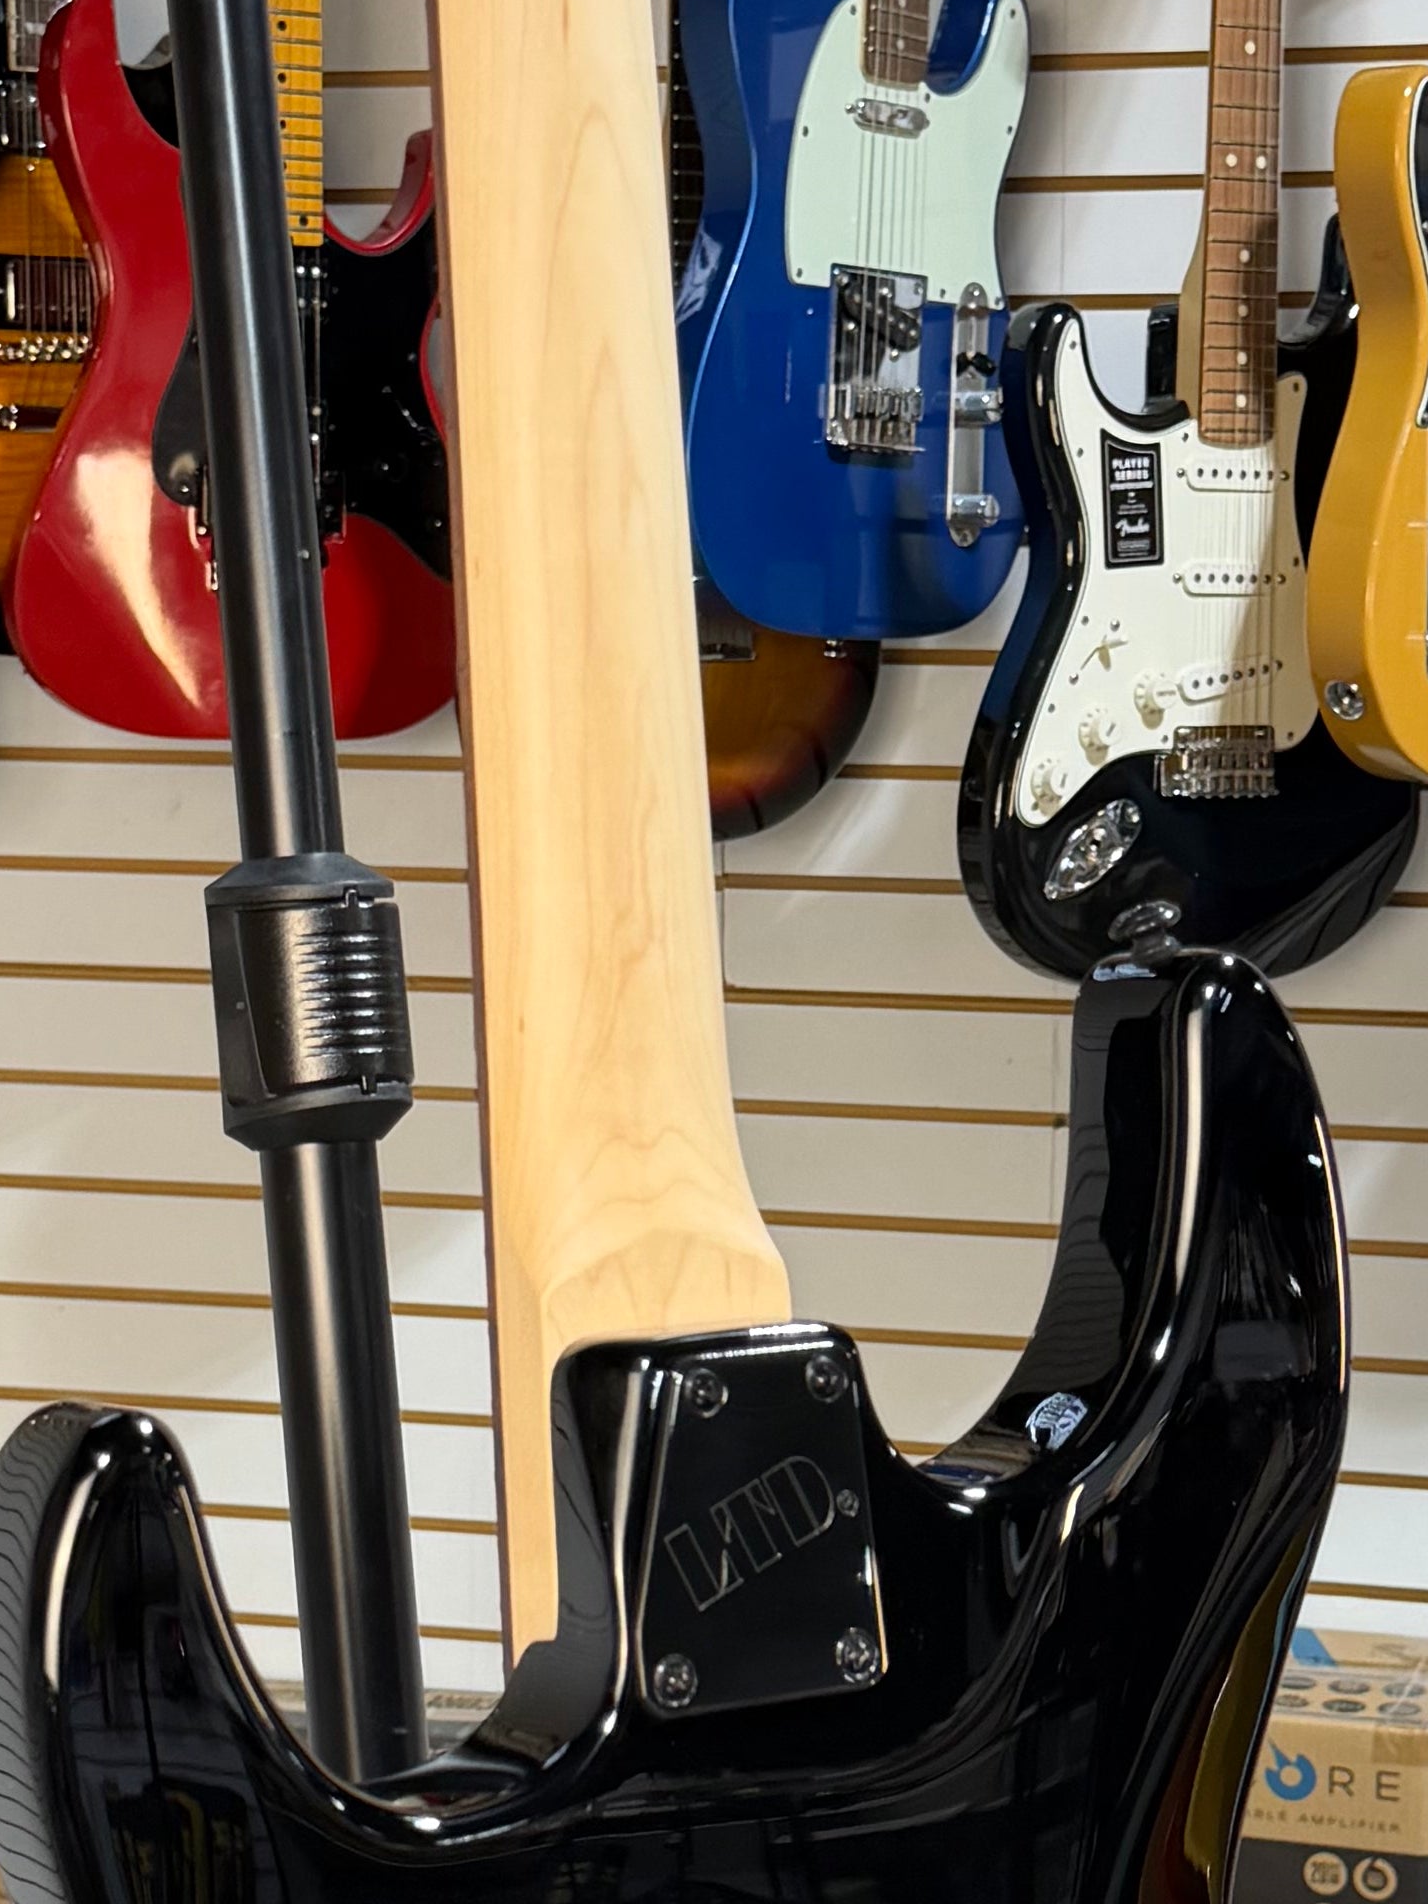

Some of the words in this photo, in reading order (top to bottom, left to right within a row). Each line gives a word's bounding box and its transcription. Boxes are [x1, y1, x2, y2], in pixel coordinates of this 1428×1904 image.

[1111, 457, 1150, 471] PLAYER
[1113, 470, 1150, 482] SERIES
[1114, 517, 1150, 538] Fender
